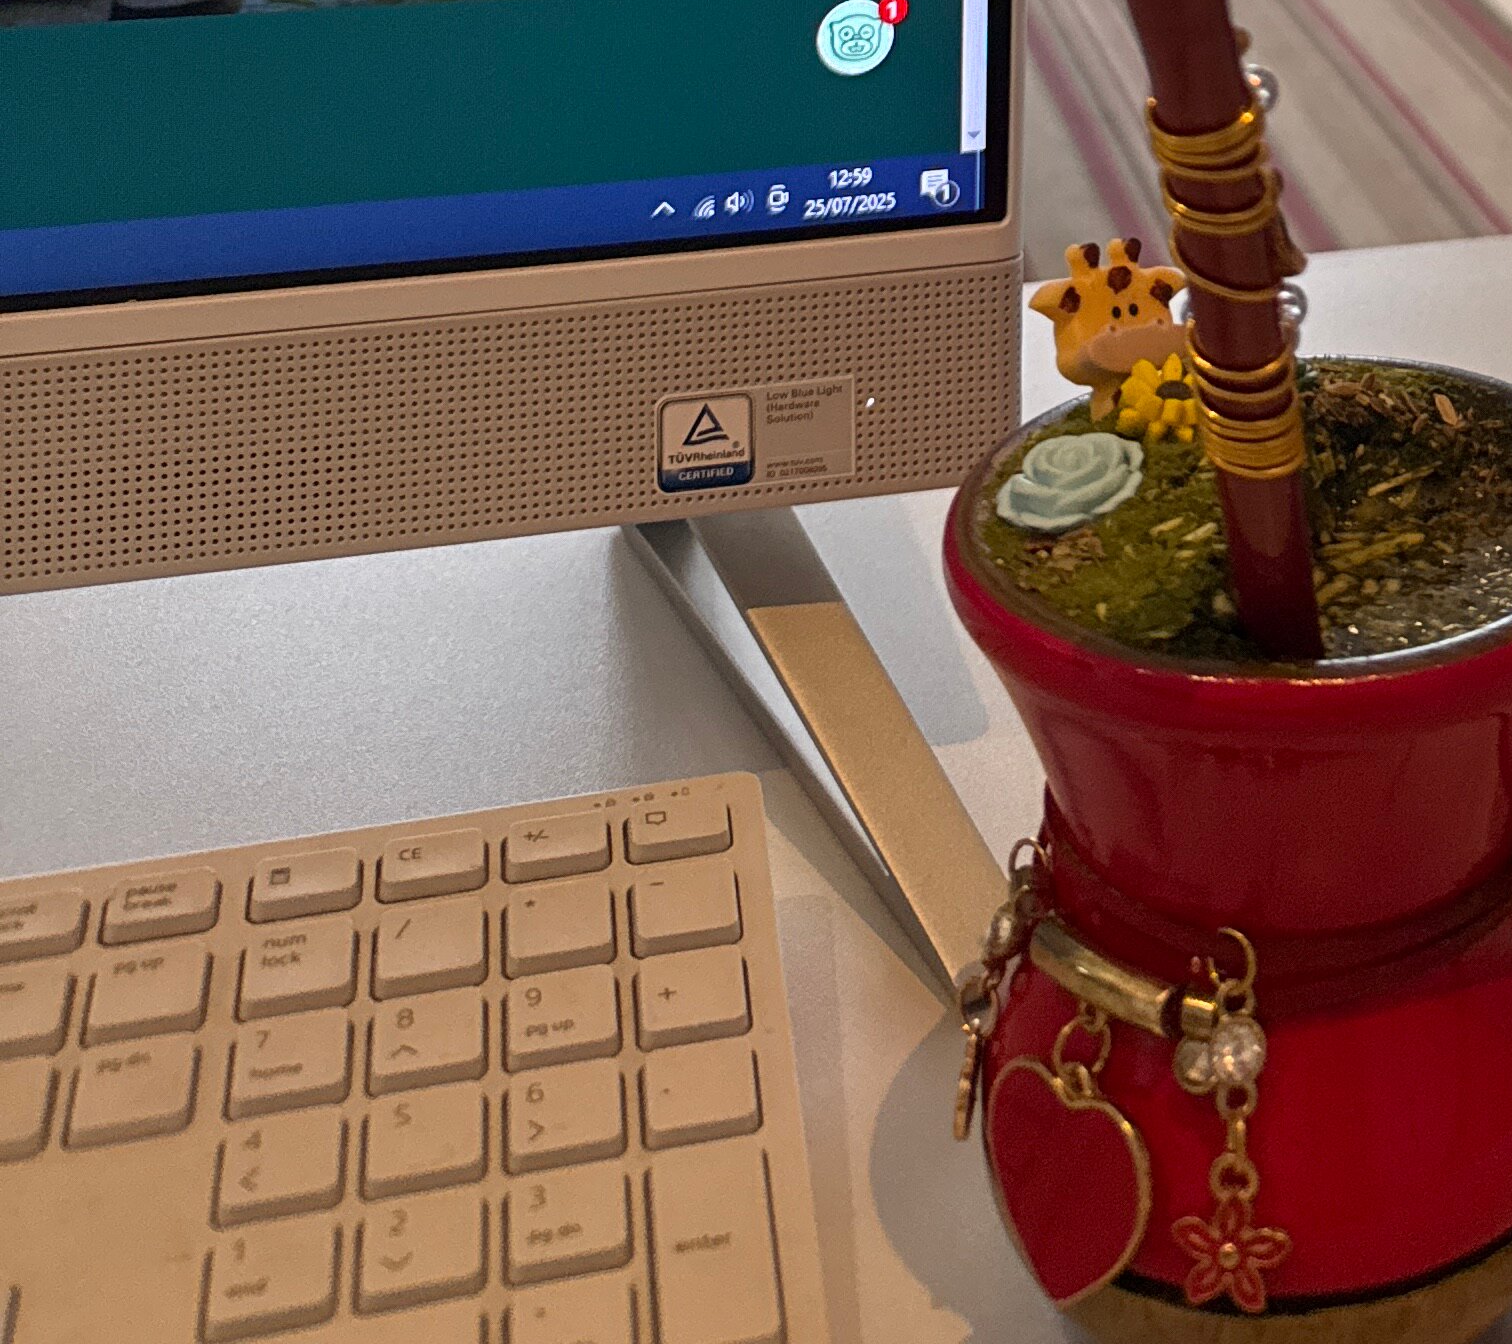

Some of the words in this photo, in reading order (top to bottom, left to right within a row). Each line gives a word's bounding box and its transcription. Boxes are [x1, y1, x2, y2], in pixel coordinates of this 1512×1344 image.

[885, 0, 898, 19] 1
[828, 167, 873, 189] 12:59
[941, 184, 950, 201] 1
[803, 192, 897, 219] 25/07/2025
[766, 391, 788, 401] Low
[791, 388, 815, 398] Blue
[817, 384, 843, 397] Light
[766, 400, 820, 412] (Hardware
[766, 411, 814, 425] Solution)
[678, 466, 735, 481] CERTIFIED
[398, 847, 422, 861] CE
[263, 934, 306, 948] num
[524, 987, 543, 1007] 9
[397, 1007, 415, 1029] 8
[257, 1030, 270, 1048] 7
[525, 1082, 544, 1104] 6
[393, 1102, 413, 1127] 5
[242, 1130, 262, 1151] 4
[528, 1184, 547, 1212] 3
[389, 1208, 408, 1237] 2
